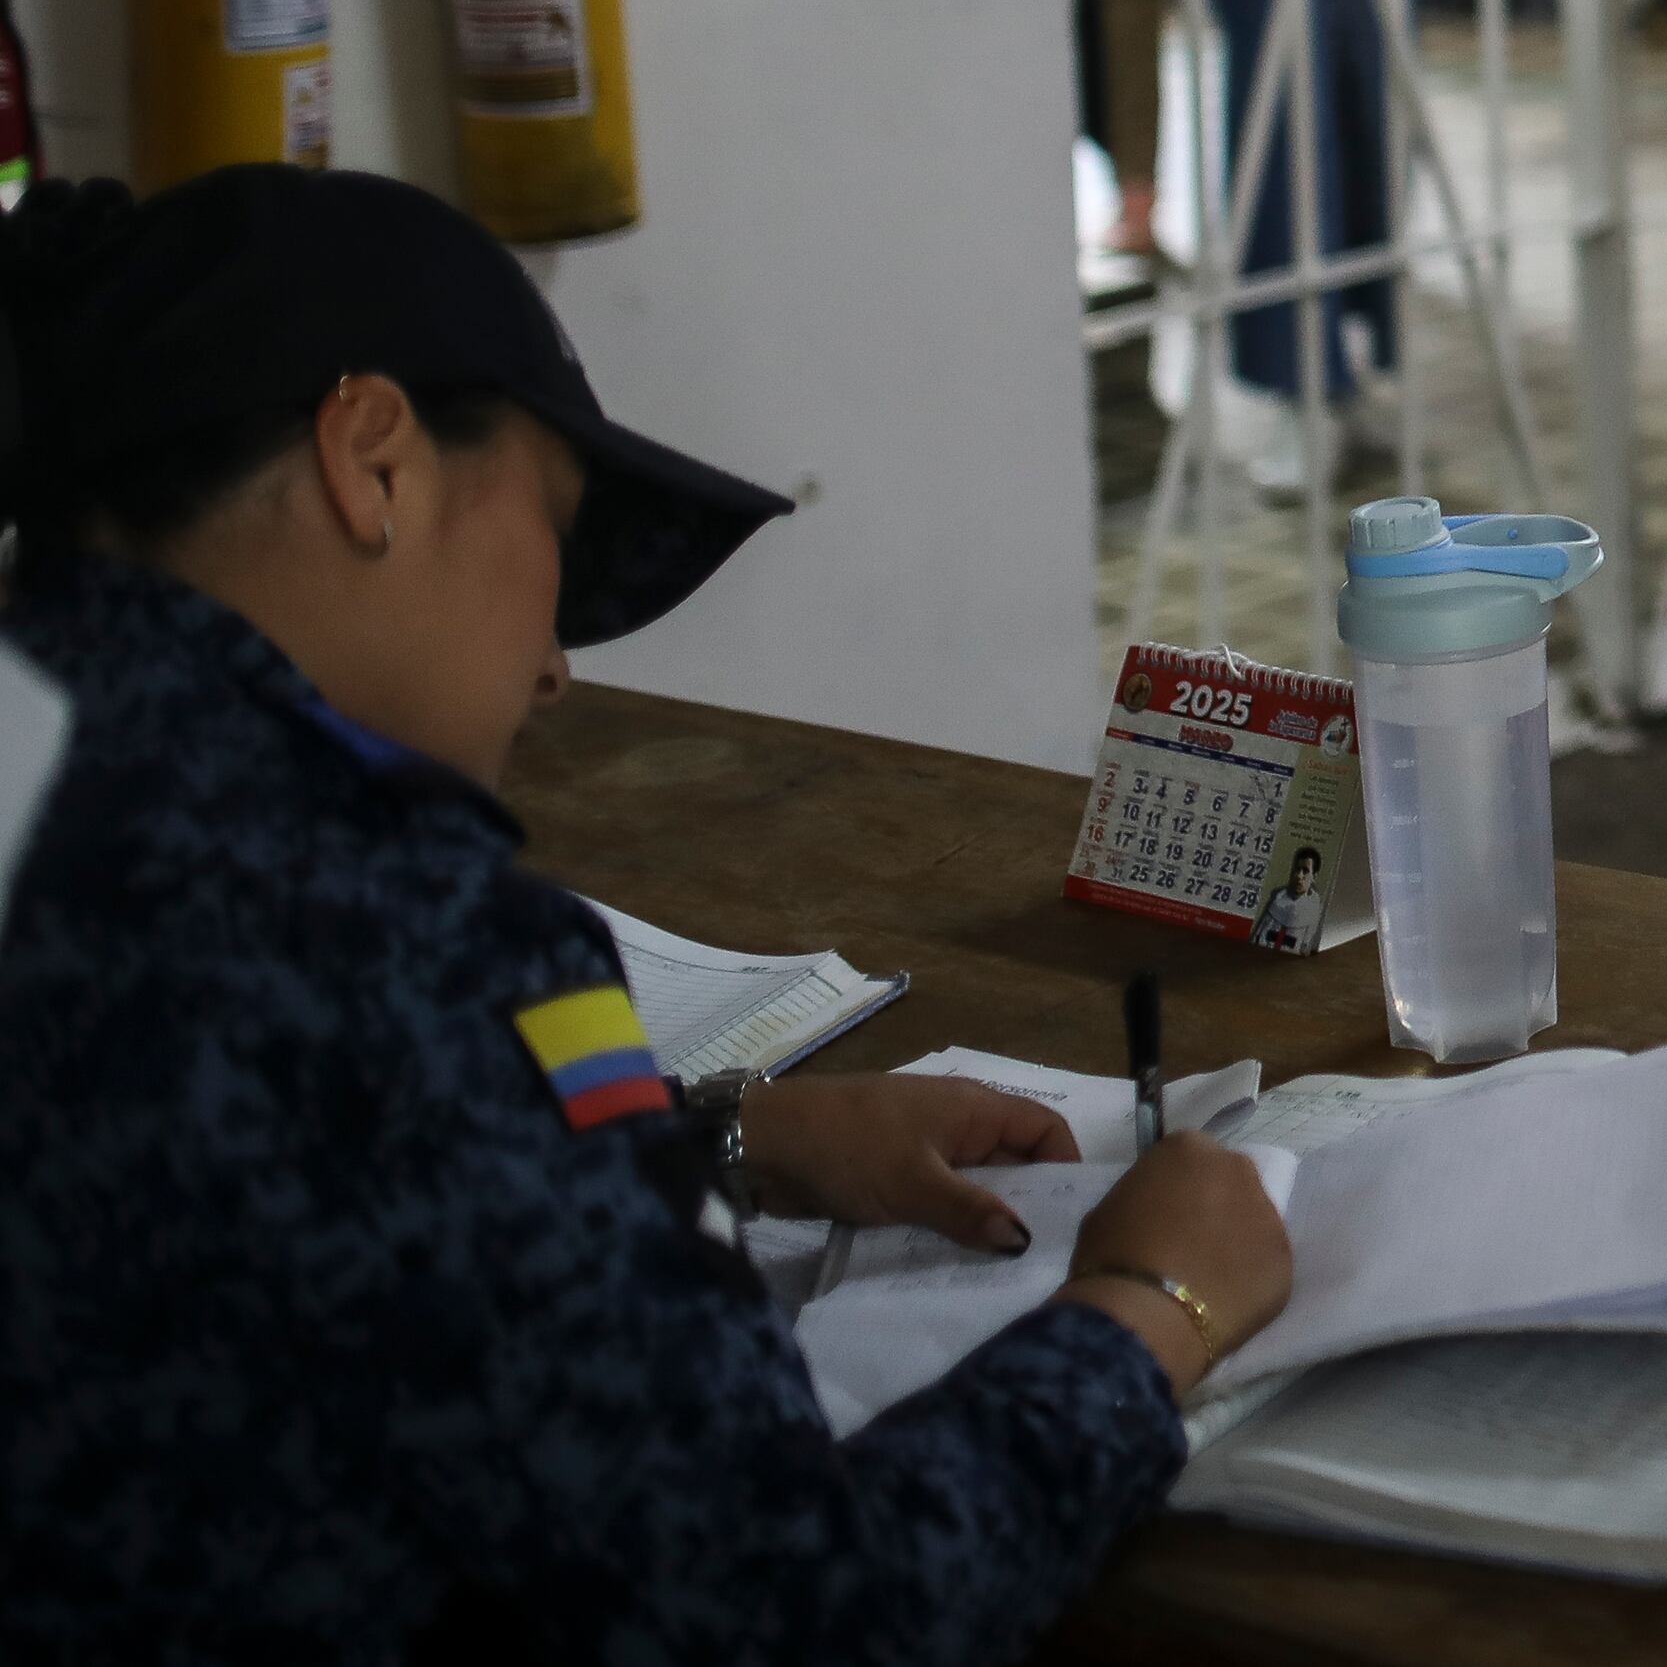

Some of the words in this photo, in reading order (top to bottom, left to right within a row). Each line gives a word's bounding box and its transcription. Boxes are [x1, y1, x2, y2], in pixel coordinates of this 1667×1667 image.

[1169, 680, 1252, 726] 2025
[1133, 778, 1143, 794] 3
[1156, 784, 1167, 800] 4
[1184, 789, 1194, 805] 5
[1212, 796, 1223, 812] 6
[1239, 802, 1251, 818] 7
[1265, 807, 1275, 825] 8
[1123, 803, 1140, 821] 10
[1146, 811, 1161, 828] 11
[1173, 817, 1191, 834] 12
[1200, 823, 1217, 841] 13
[1228, 831, 1246, 848] 14
[1254, 837, 1272, 853] 15
[1087, 824, 1104, 843] 16
[1114, 831, 1133, 848] 17
[1139, 838, 1157, 855] 18
[1165, 843, 1183, 861] 19
[1192, 850, 1212, 869] 20
[1220, 858, 1238, 875] 21
[1245, 862, 1265, 881] 22
[1129, 865, 1149, 883] 25
[1156, 870, 1175, 888] 26
[1185, 877, 1204, 896] 27
[1212, 884, 1231, 903] 28
[1237, 891, 1257, 909] 29
